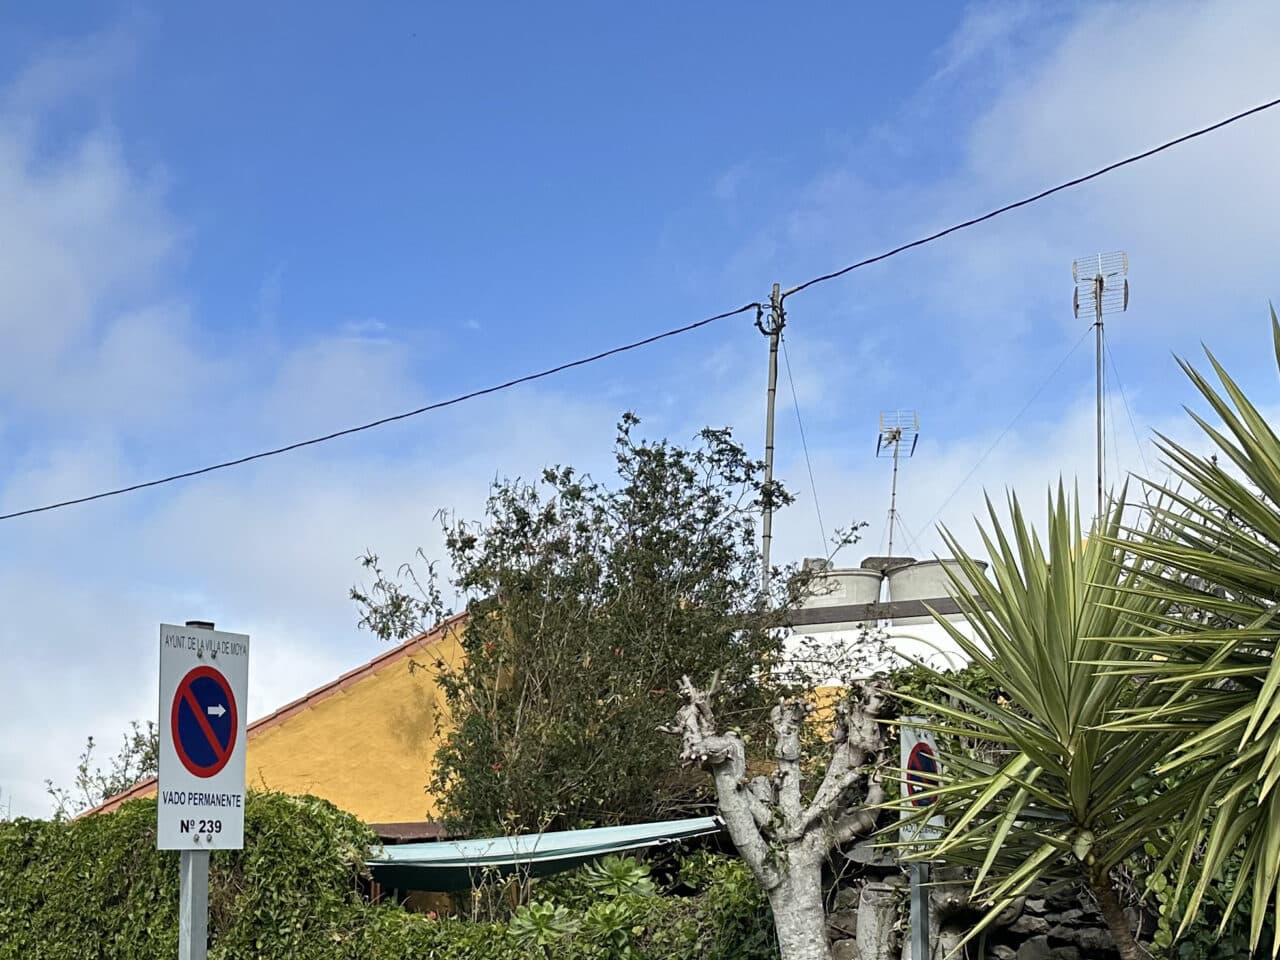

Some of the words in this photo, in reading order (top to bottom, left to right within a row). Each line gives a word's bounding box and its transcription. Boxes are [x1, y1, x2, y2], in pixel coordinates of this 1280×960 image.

[187, 637, 197, 650] DE
[197, 638, 205, 650] LA
[205, 639, 221, 652] VILLA
[221, 641, 230, 655] DE
[230, 642, 247, 657] MOYA
[162, 791, 186, 805] VADO
[187, 792, 241, 808] PERMANENTE
[180, 819, 195, 833] Nº
[198, 819, 222, 833] 239
